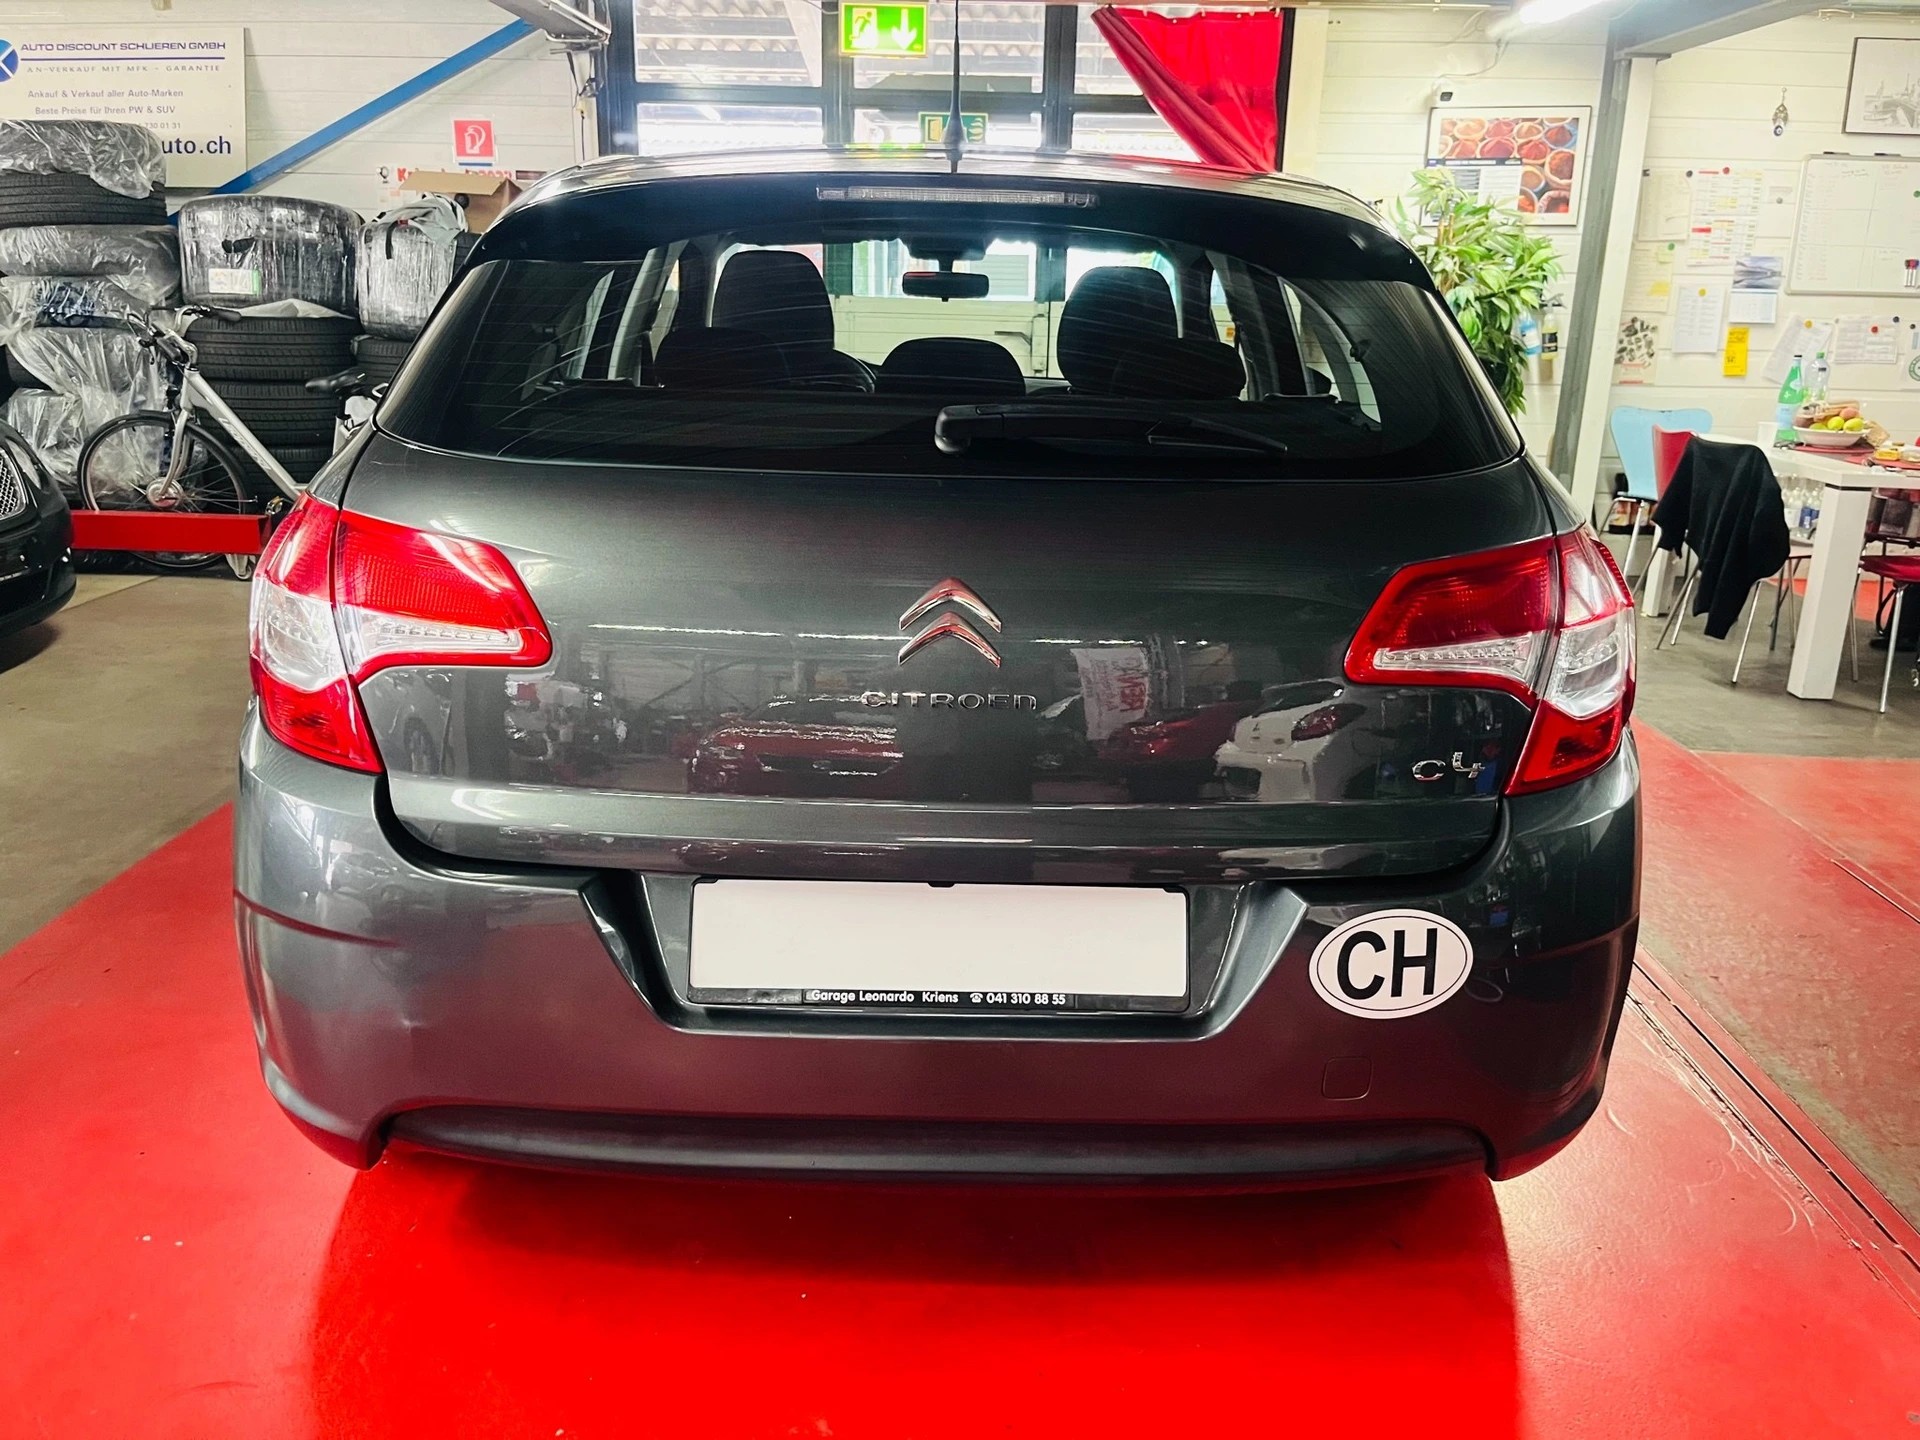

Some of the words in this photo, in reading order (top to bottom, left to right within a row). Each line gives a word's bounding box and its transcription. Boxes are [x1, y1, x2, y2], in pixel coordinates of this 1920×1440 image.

[20, 43, 54, 51] AUTO
[56, 42, 117, 51] DISCOUNT
[188, 42, 226, 50] GMBH
[27, 65, 96, 73] AN-VERKAUF
[28, 90, 58, 98] Ankauf
[61, 90, 68, 98] &
[71, 89, 104, 98] Verkauf
[107, 89, 125, 97] aller
[128, 88, 184, 97] Auto-Marken
[35, 106, 59, 115] Beste
[61, 106, 87, 115] Preise
[90, 105, 102, 114] für
[104, 105, 126, 114] Ihren
[128, 105, 143, 114] PW
[146, 105, 153, 114] &
[156, 105, 176, 114] SUV
[161, 135, 232, 155] uto.ch
[1337, 928, 1438, 1000] CH
[811, 990, 855, 1003] Garage
[859, 990, 915, 1003] Leonardo
[922, 991, 959, 1004] Kriens
[986, 992, 1007, 1004] 041
[1010, 993, 1030, 1005] 310
[1034, 993, 1049, 1005] 88
[1052, 994, 1067, 1006] 55
